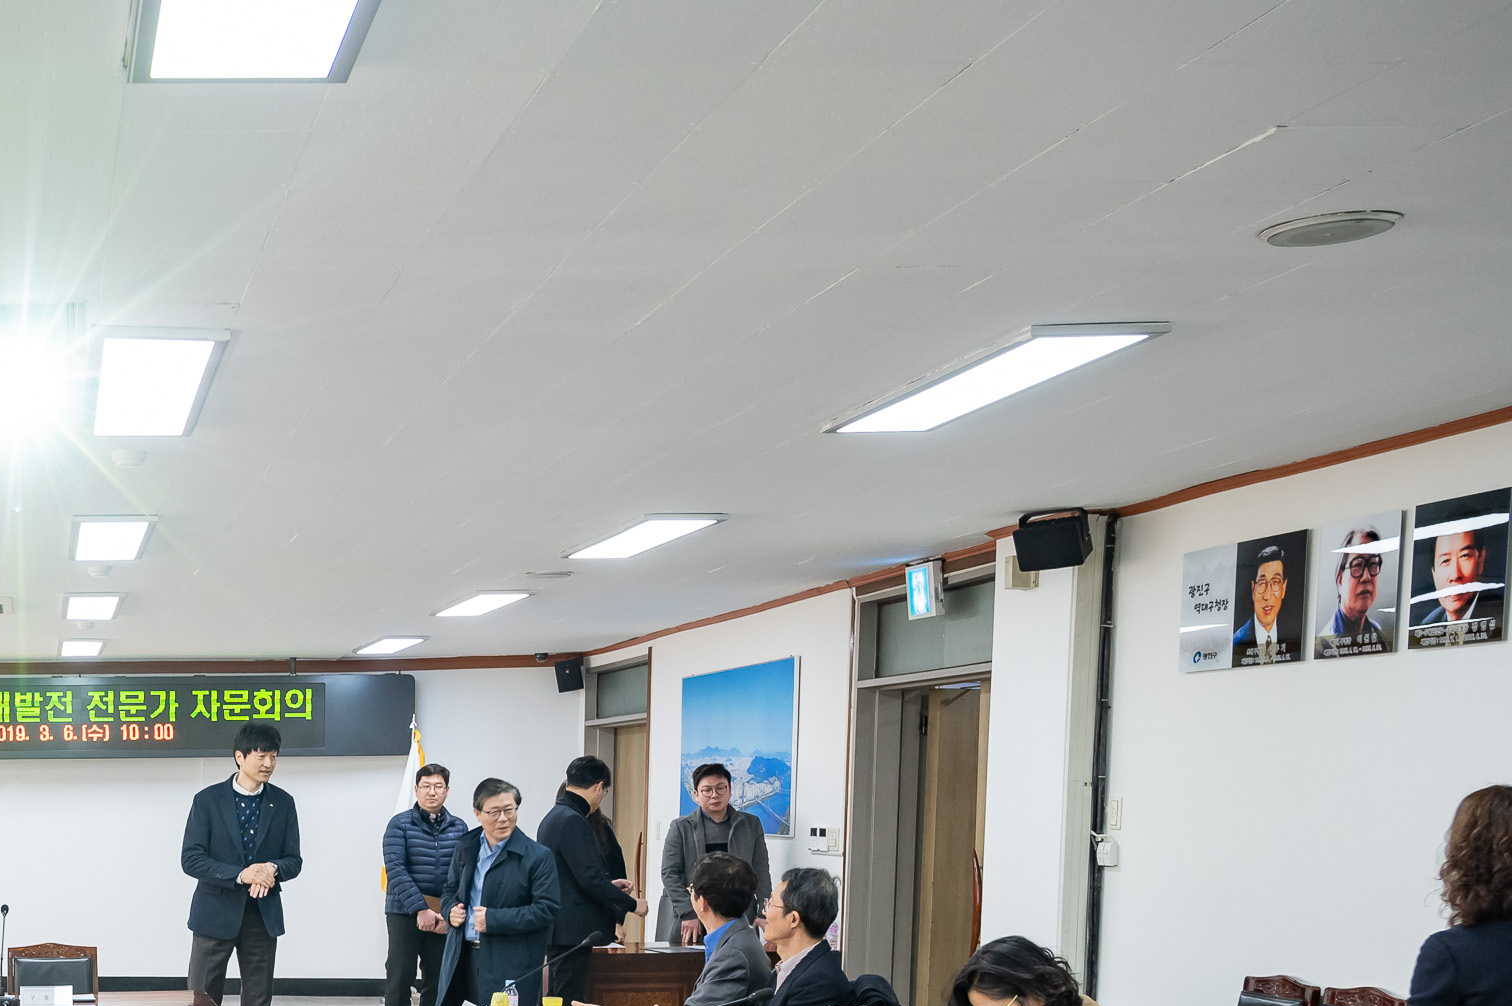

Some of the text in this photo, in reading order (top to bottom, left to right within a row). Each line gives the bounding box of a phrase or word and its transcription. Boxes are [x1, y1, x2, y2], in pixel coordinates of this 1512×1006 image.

[1188, 583, 1210, 598] 광진구
[1194, 599, 1229, 614] 역대구청장
[87, 690, 179, 722] 전문가
[190, 688, 313, 722] 자문회의
[39, 724, 54, 742] 3.
